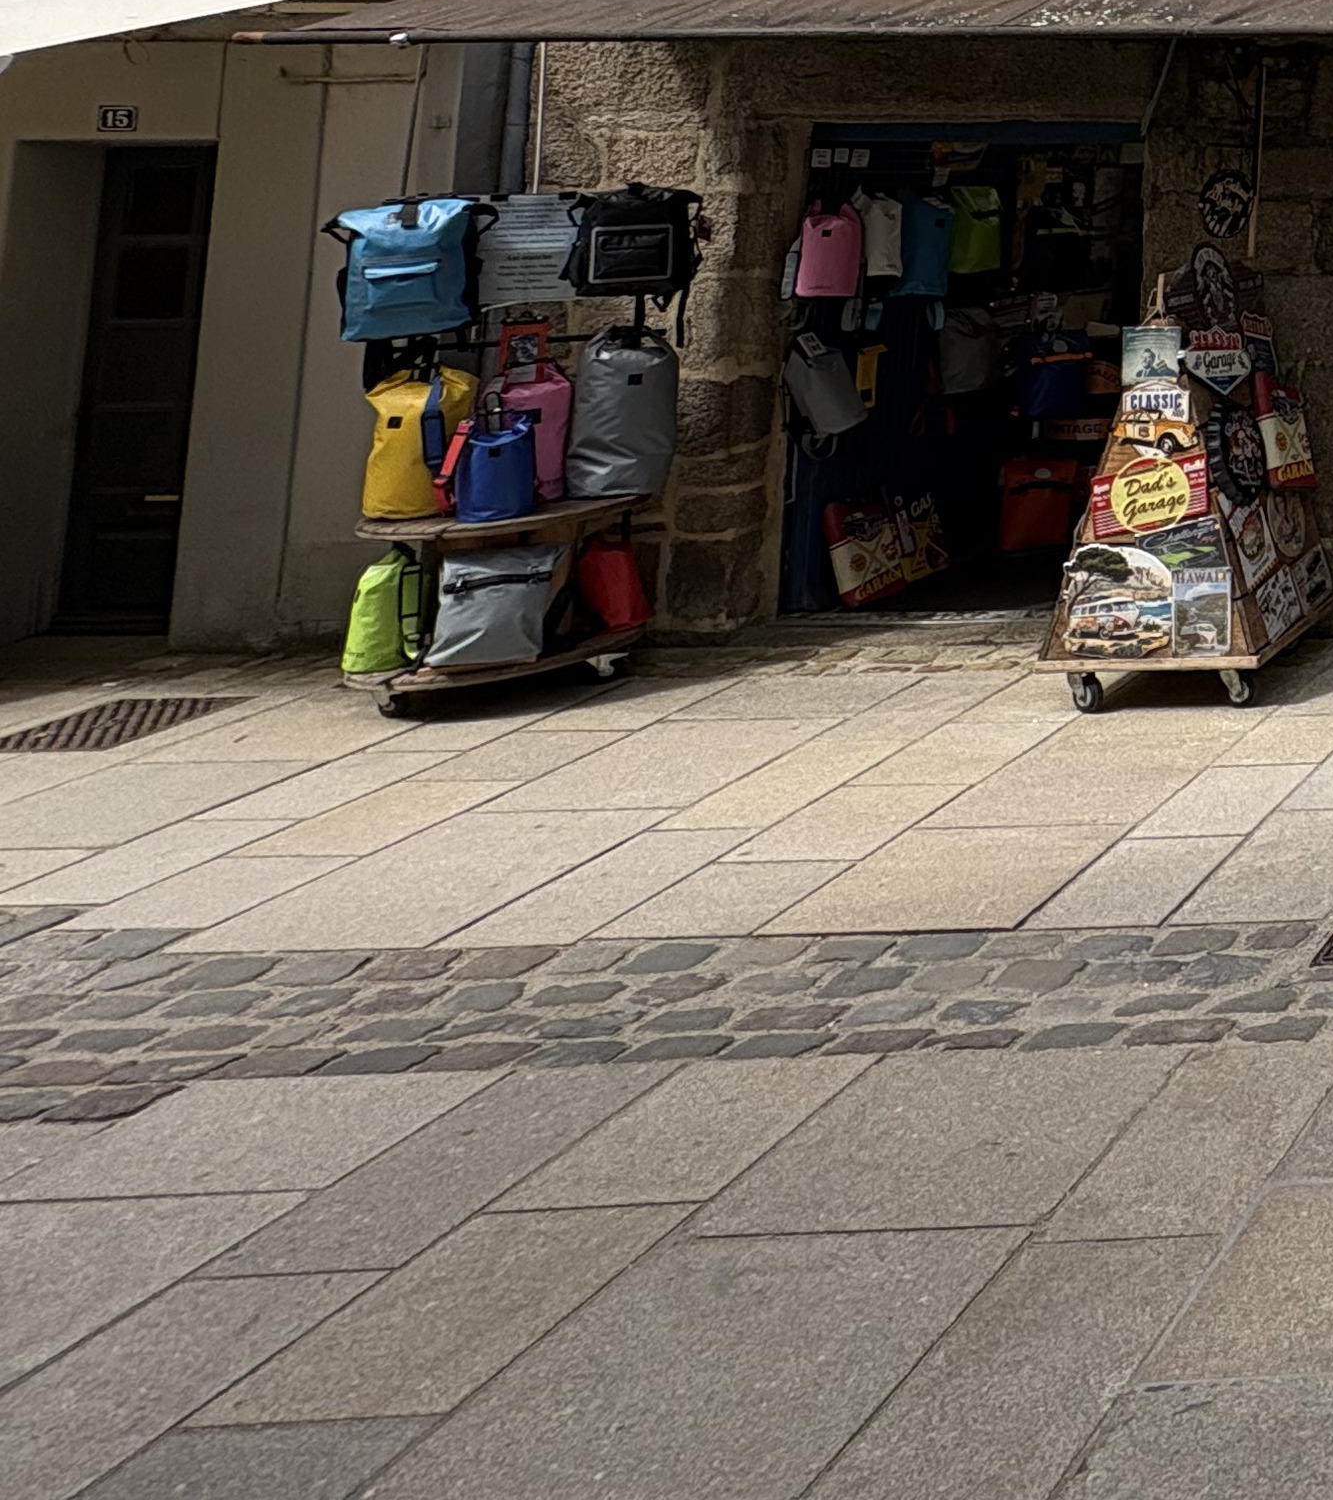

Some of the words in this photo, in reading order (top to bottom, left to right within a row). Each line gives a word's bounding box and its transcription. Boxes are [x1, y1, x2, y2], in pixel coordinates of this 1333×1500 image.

[106, 110, 129, 127] 15
[1129, 392, 1183, 411] CLASSIC
[1123, 470, 1178, 498] Dad's
[1122, 493, 1187, 525] Garage
